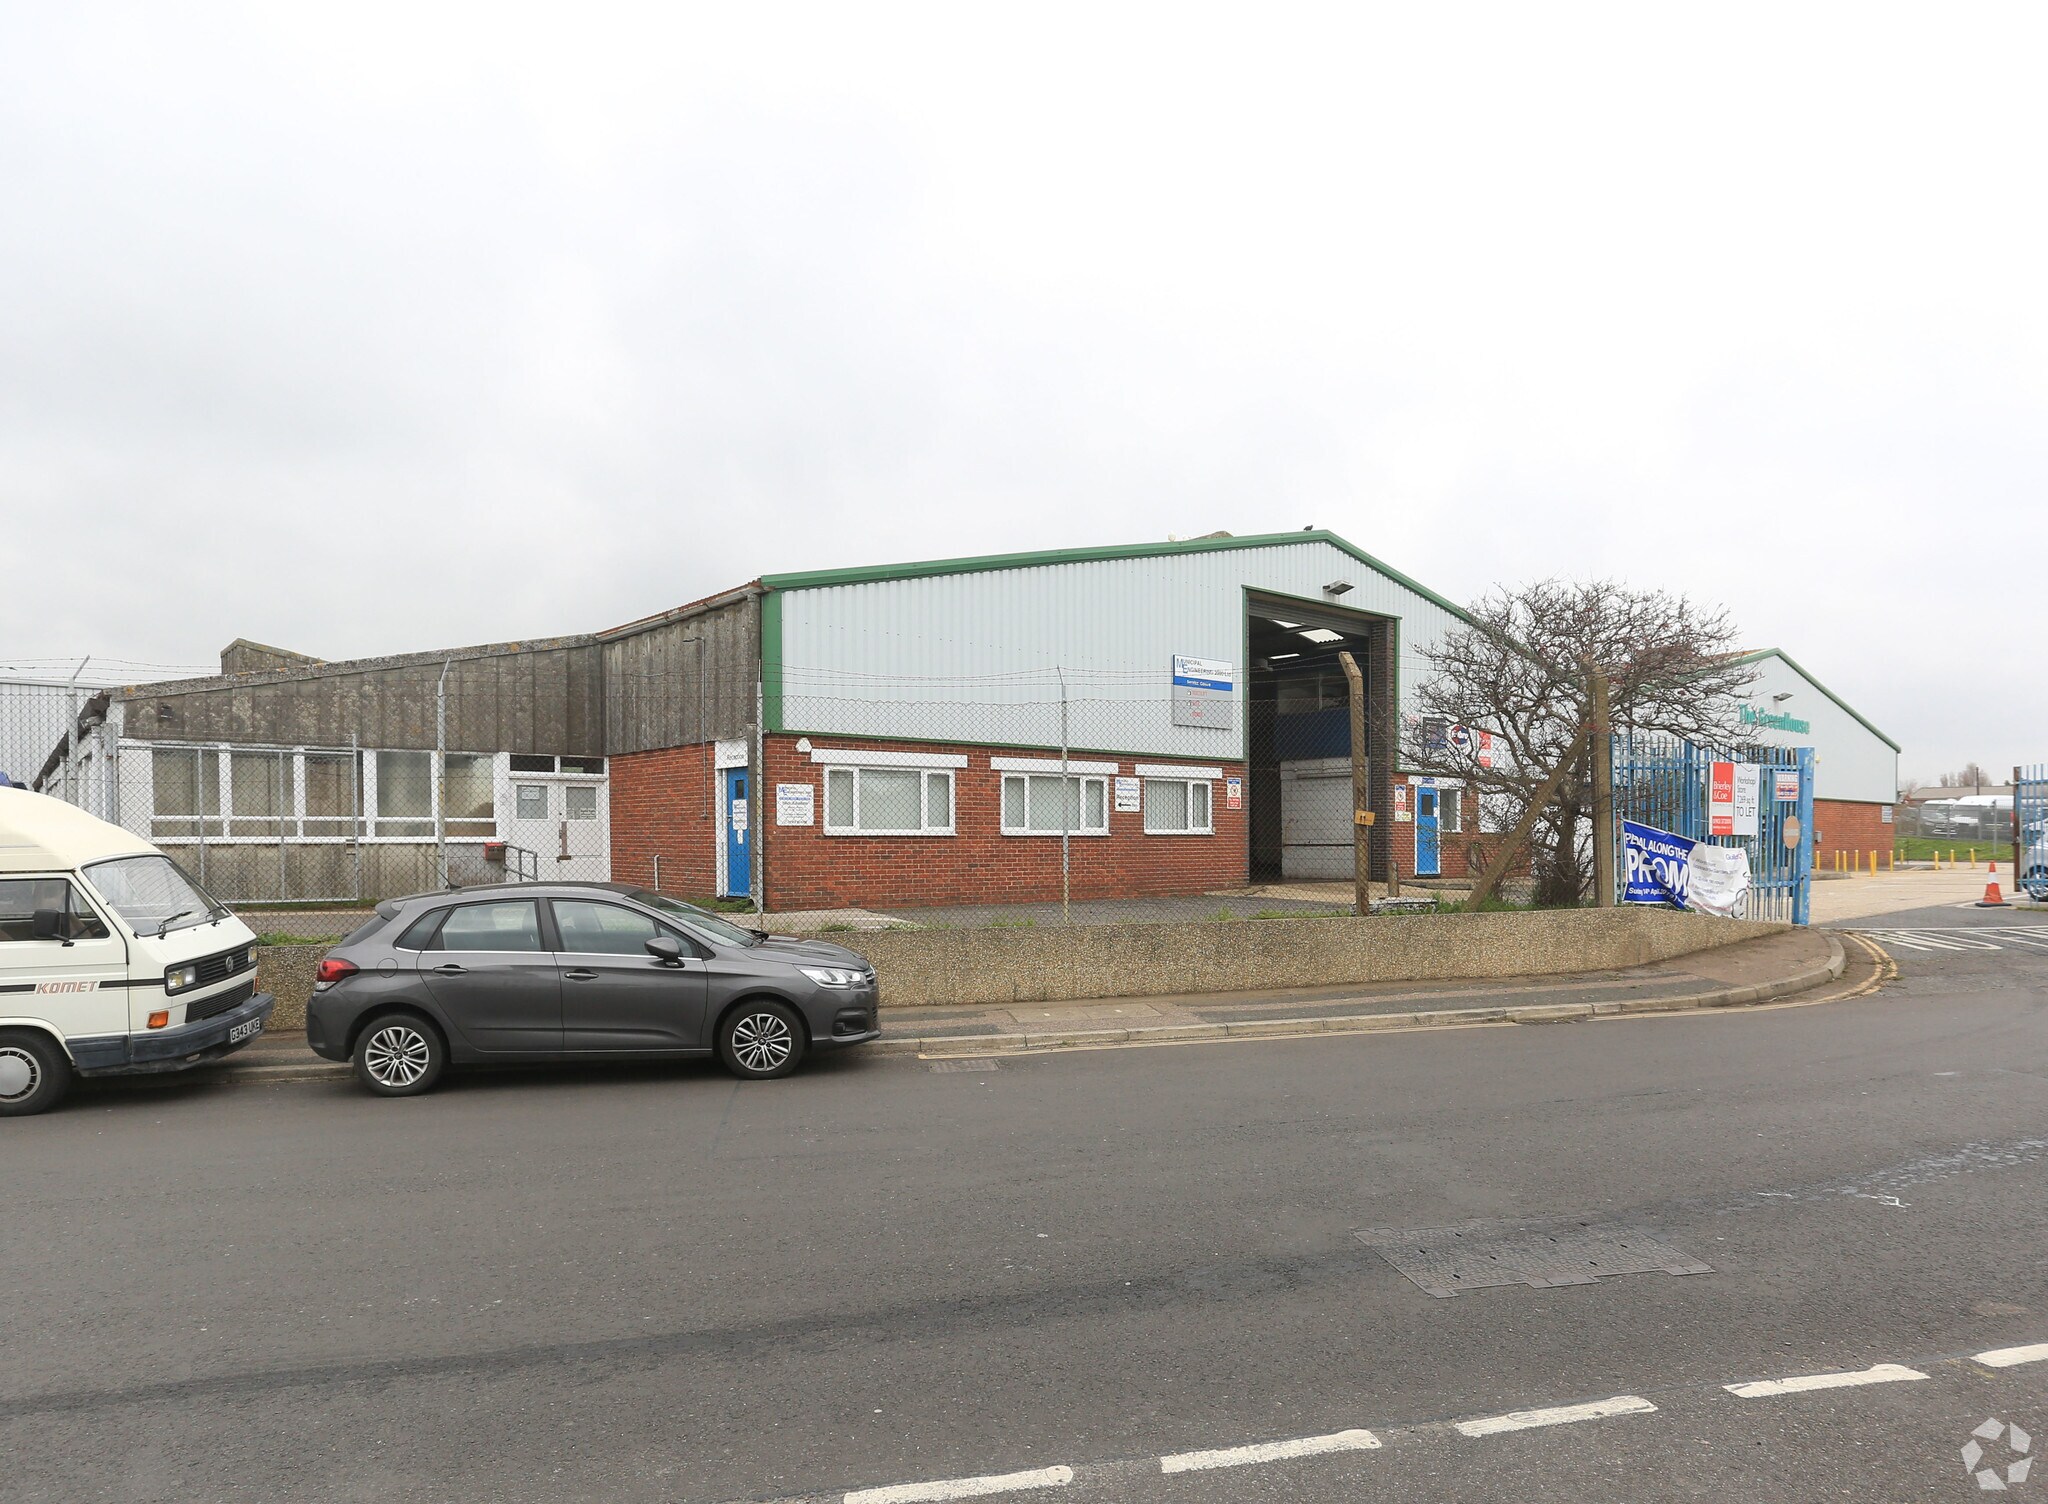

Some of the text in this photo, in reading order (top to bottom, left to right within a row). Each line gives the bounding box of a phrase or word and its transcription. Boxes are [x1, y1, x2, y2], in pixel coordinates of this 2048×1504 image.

[1713, 781, 1732, 793] Brierley
[1736, 806, 1756, 818] TO LET
[1647, 840, 1675, 857] ALONG
[1675, 846, 1688, 861] THE
[1627, 847, 1688, 896] PROM
[36, 981, 97, 995] KOMET
